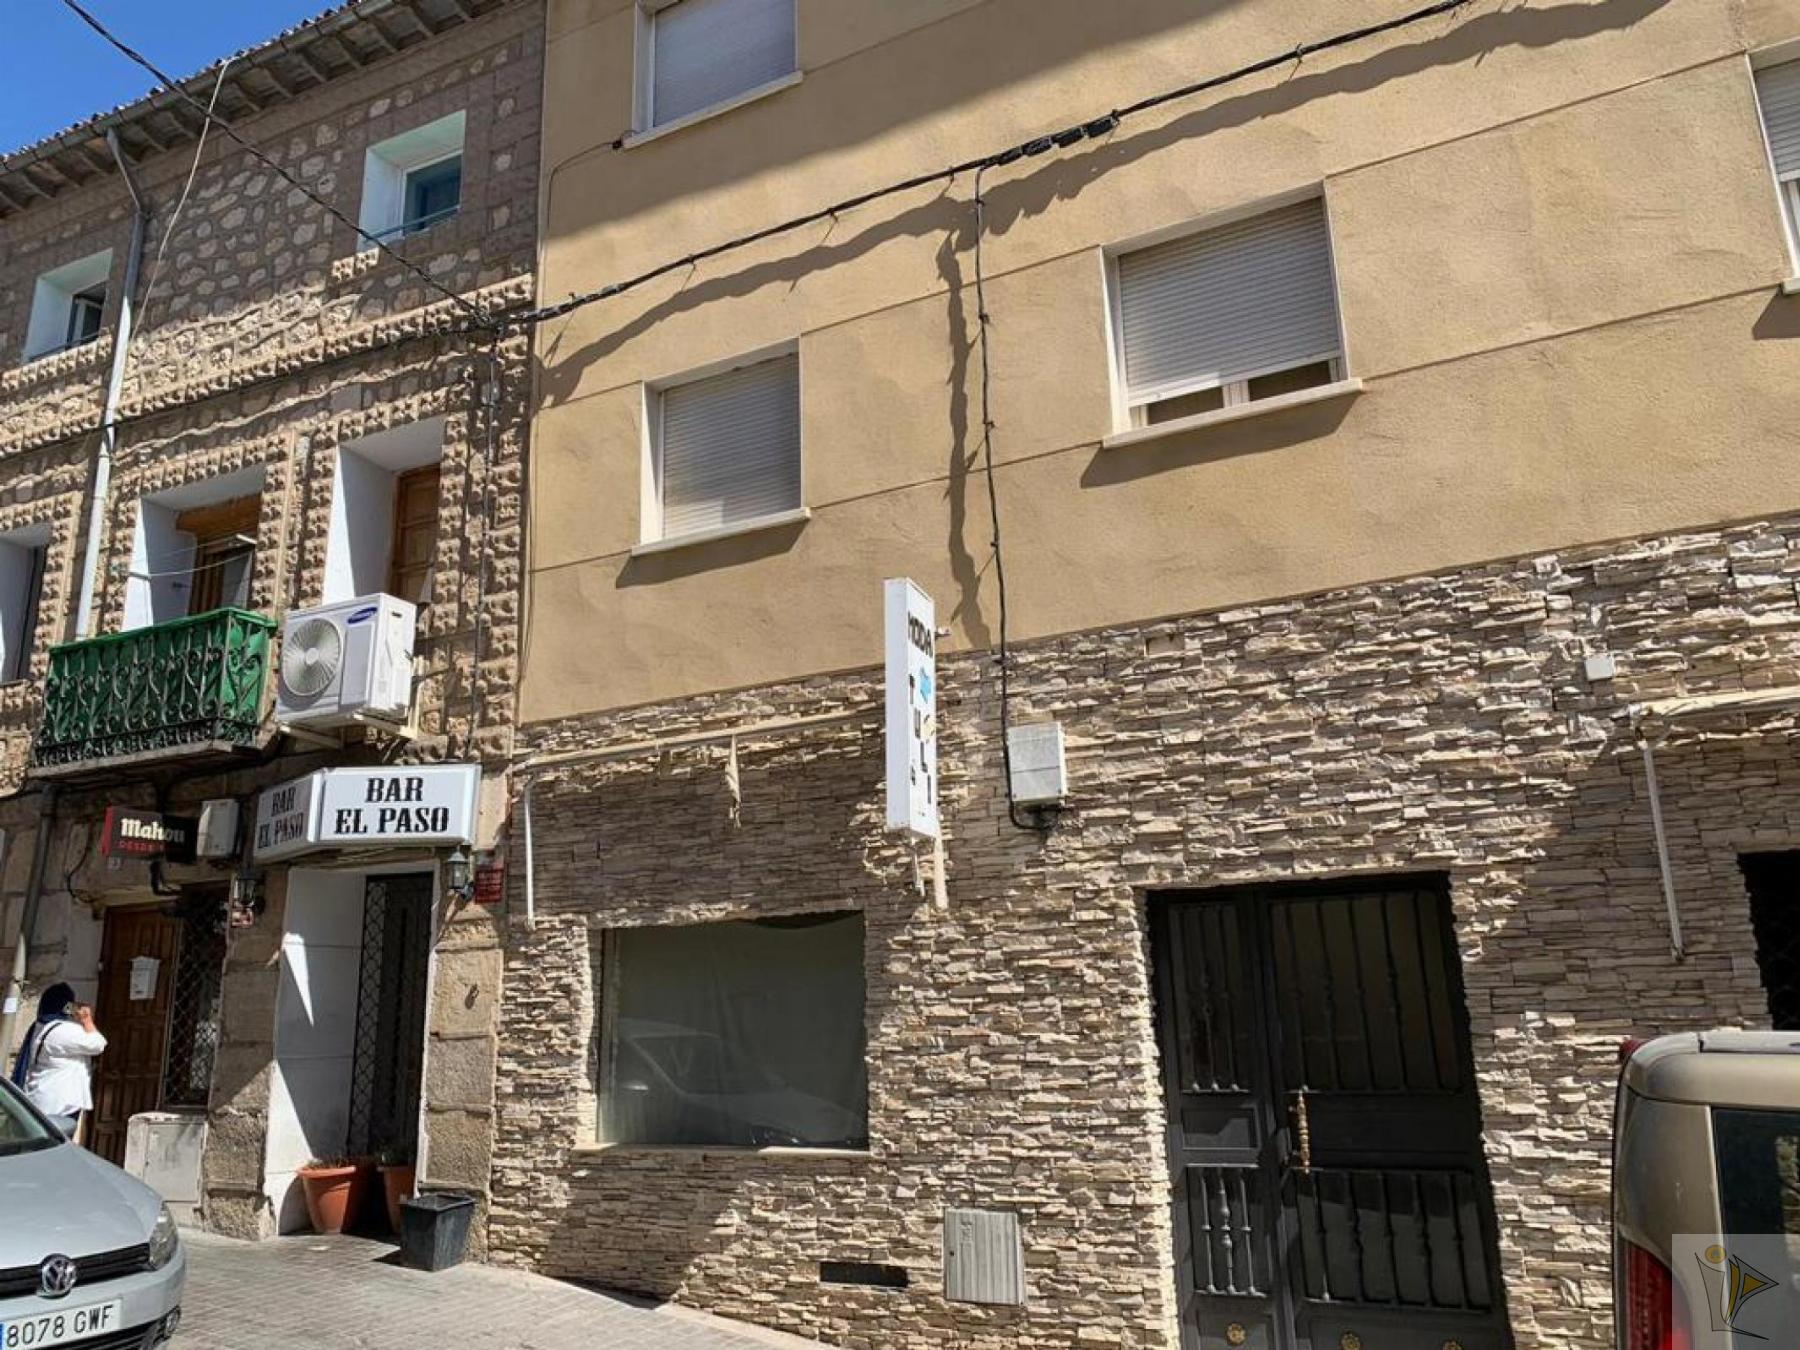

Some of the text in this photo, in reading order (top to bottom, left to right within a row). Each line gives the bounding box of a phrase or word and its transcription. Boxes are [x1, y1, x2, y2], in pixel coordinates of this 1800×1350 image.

[271, 786, 297, 817] BAR
[366, 776, 423, 802] BAR
[120, 818, 185, 843] Mahou
[257, 812, 304, 849] EL PASO
[335, 806, 449, 834] EL PASO
[6, 1303, 114, 1348] 8078 GWF
